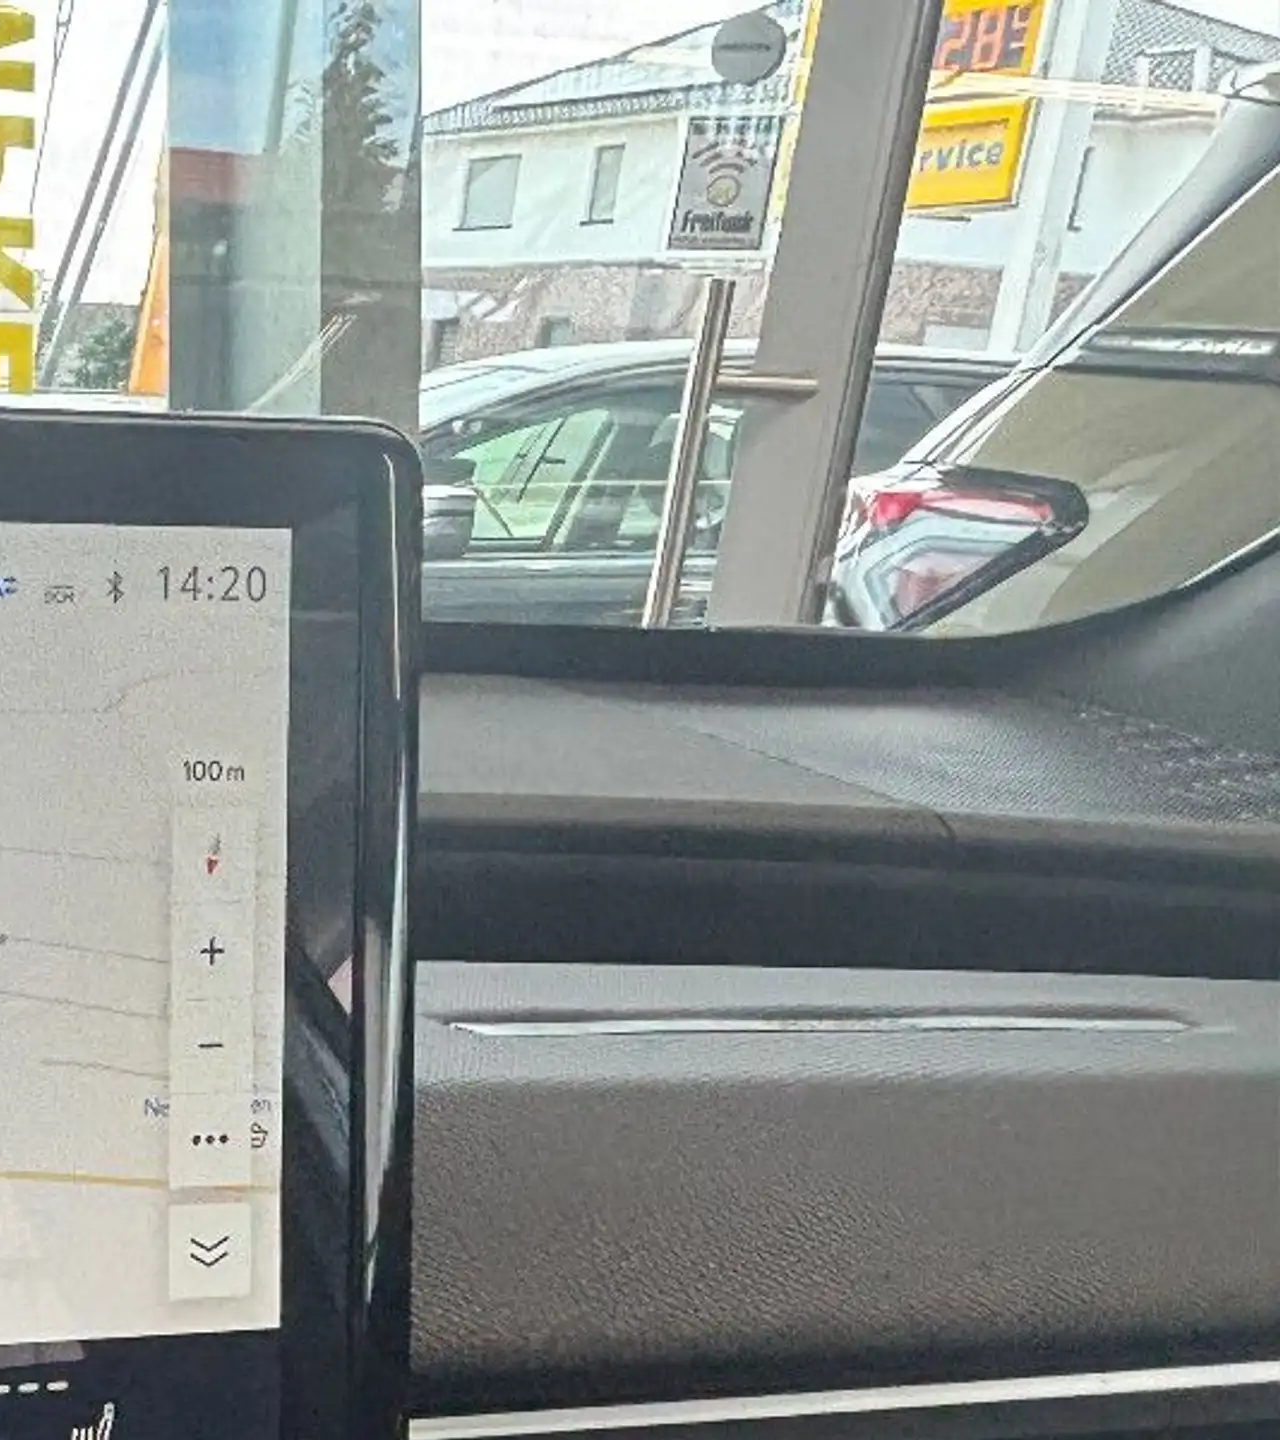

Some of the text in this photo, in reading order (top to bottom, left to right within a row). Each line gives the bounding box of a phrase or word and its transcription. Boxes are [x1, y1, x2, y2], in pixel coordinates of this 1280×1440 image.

[158, 565, 267, 602] 14:20
[184, 760, 245, 782] 100 m
